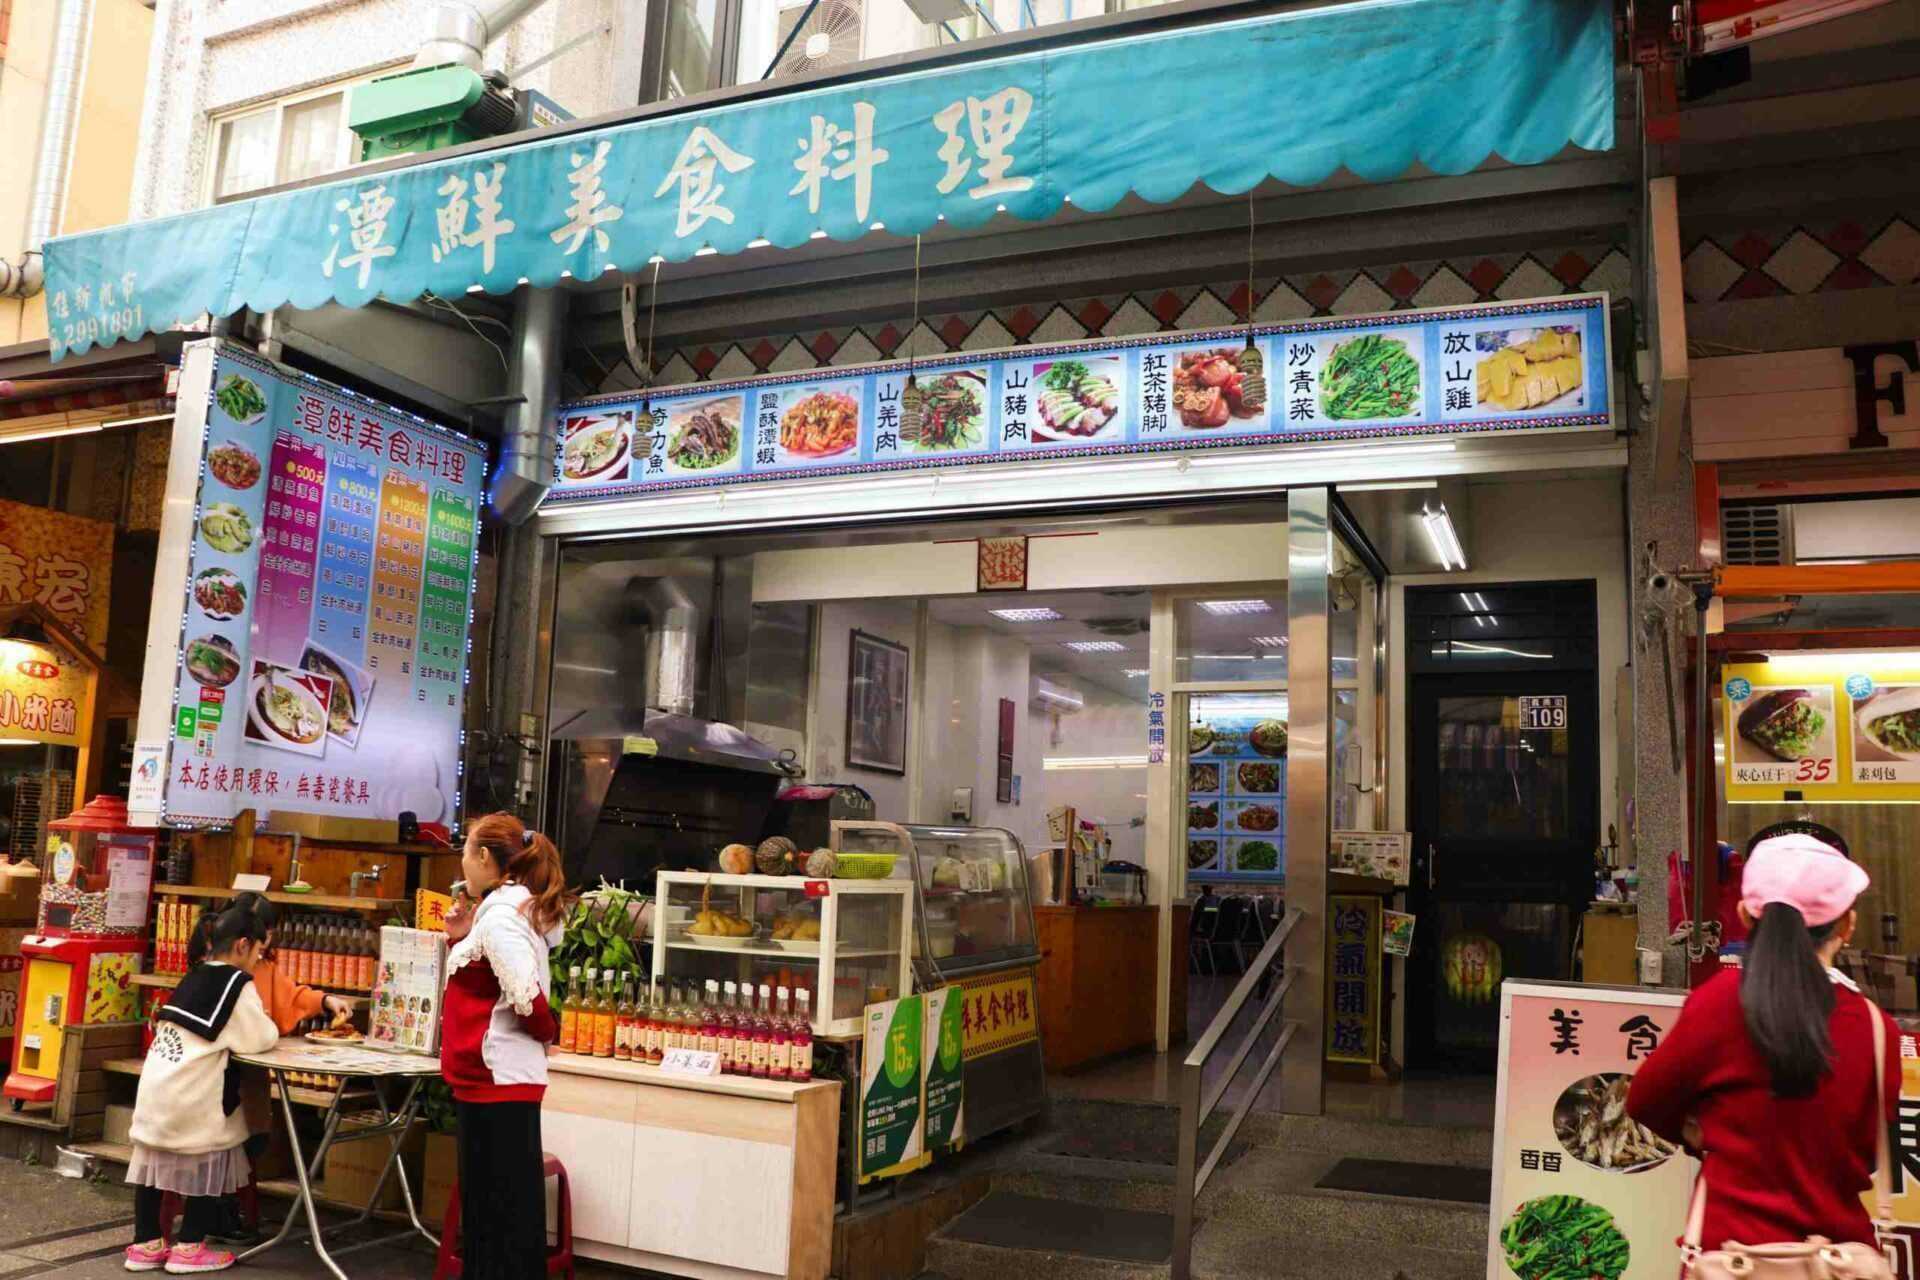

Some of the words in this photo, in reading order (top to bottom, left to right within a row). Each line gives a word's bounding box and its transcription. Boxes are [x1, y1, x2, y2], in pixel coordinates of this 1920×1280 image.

[322, 86, 1034, 290] 潭鮮美食料理
[1003, 369, 1029, 442] 山豬肉
[1288, 343, 1316, 421] 炒青菜
[1443, 331, 1473, 412] 放山雞
[294, 395, 466, 484] 潭鮮美食料理
[645, 406, 669, 475] 奇力魚
[755, 393, 779, 465] 鹽酥潭蝦
[875, 382, 899, 453] 山羌肉
[1149, 691, 1165, 764] 冷氣開放
[1530, 708, 1564, 727] 109
[1796, 758, 1832, 781] 35
[1334, 905, 1368, 1055] 冷氣開放
[1548, 1008, 1662, 1060] 美食
[1519, 1149, 1563, 1173] 香香
